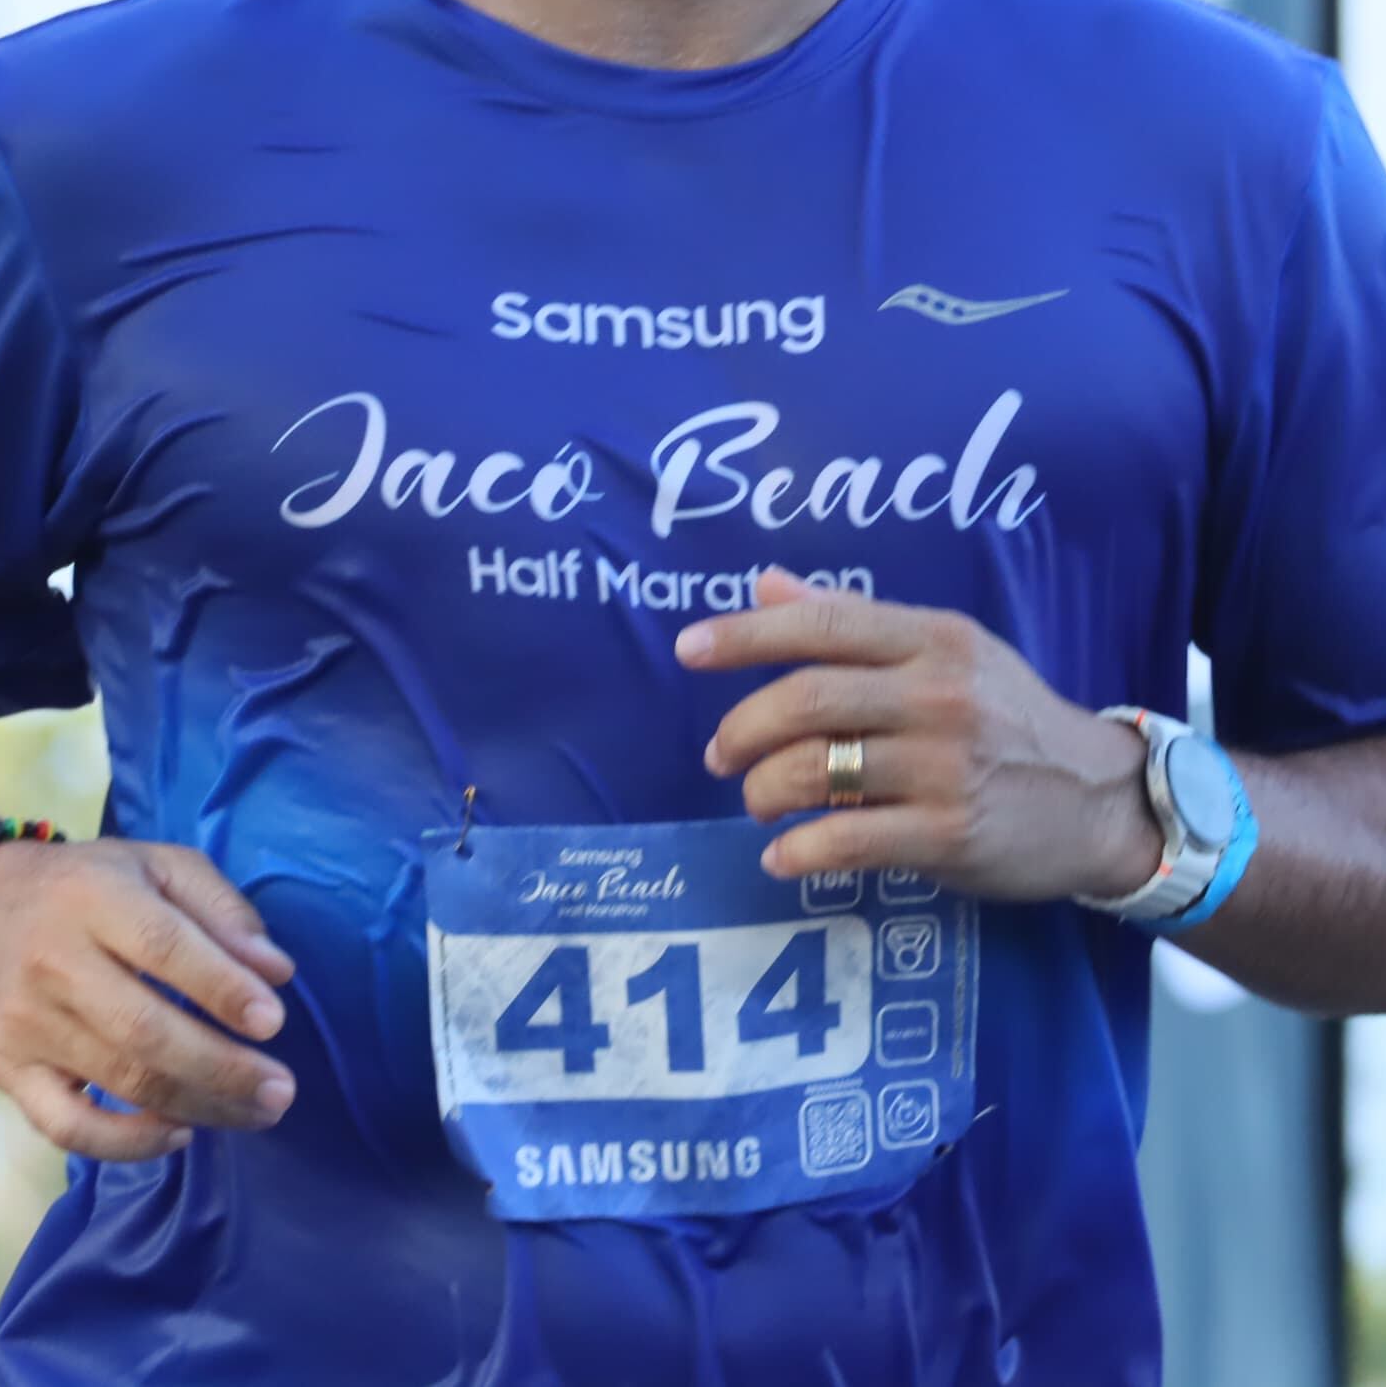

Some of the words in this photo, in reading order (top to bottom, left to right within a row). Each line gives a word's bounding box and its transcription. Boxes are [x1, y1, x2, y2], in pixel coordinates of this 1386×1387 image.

[491, 289, 826, 354] Samsung
[650, 388, 1047, 539] Beach
[467, 546, 581, 600] Half
[596, 556, 874, 612] Maraton
[597, 864, 687, 902] Beach
[495, 929, 842, 1074] 414
[516, 1138, 762, 1188] SAMSUNG
